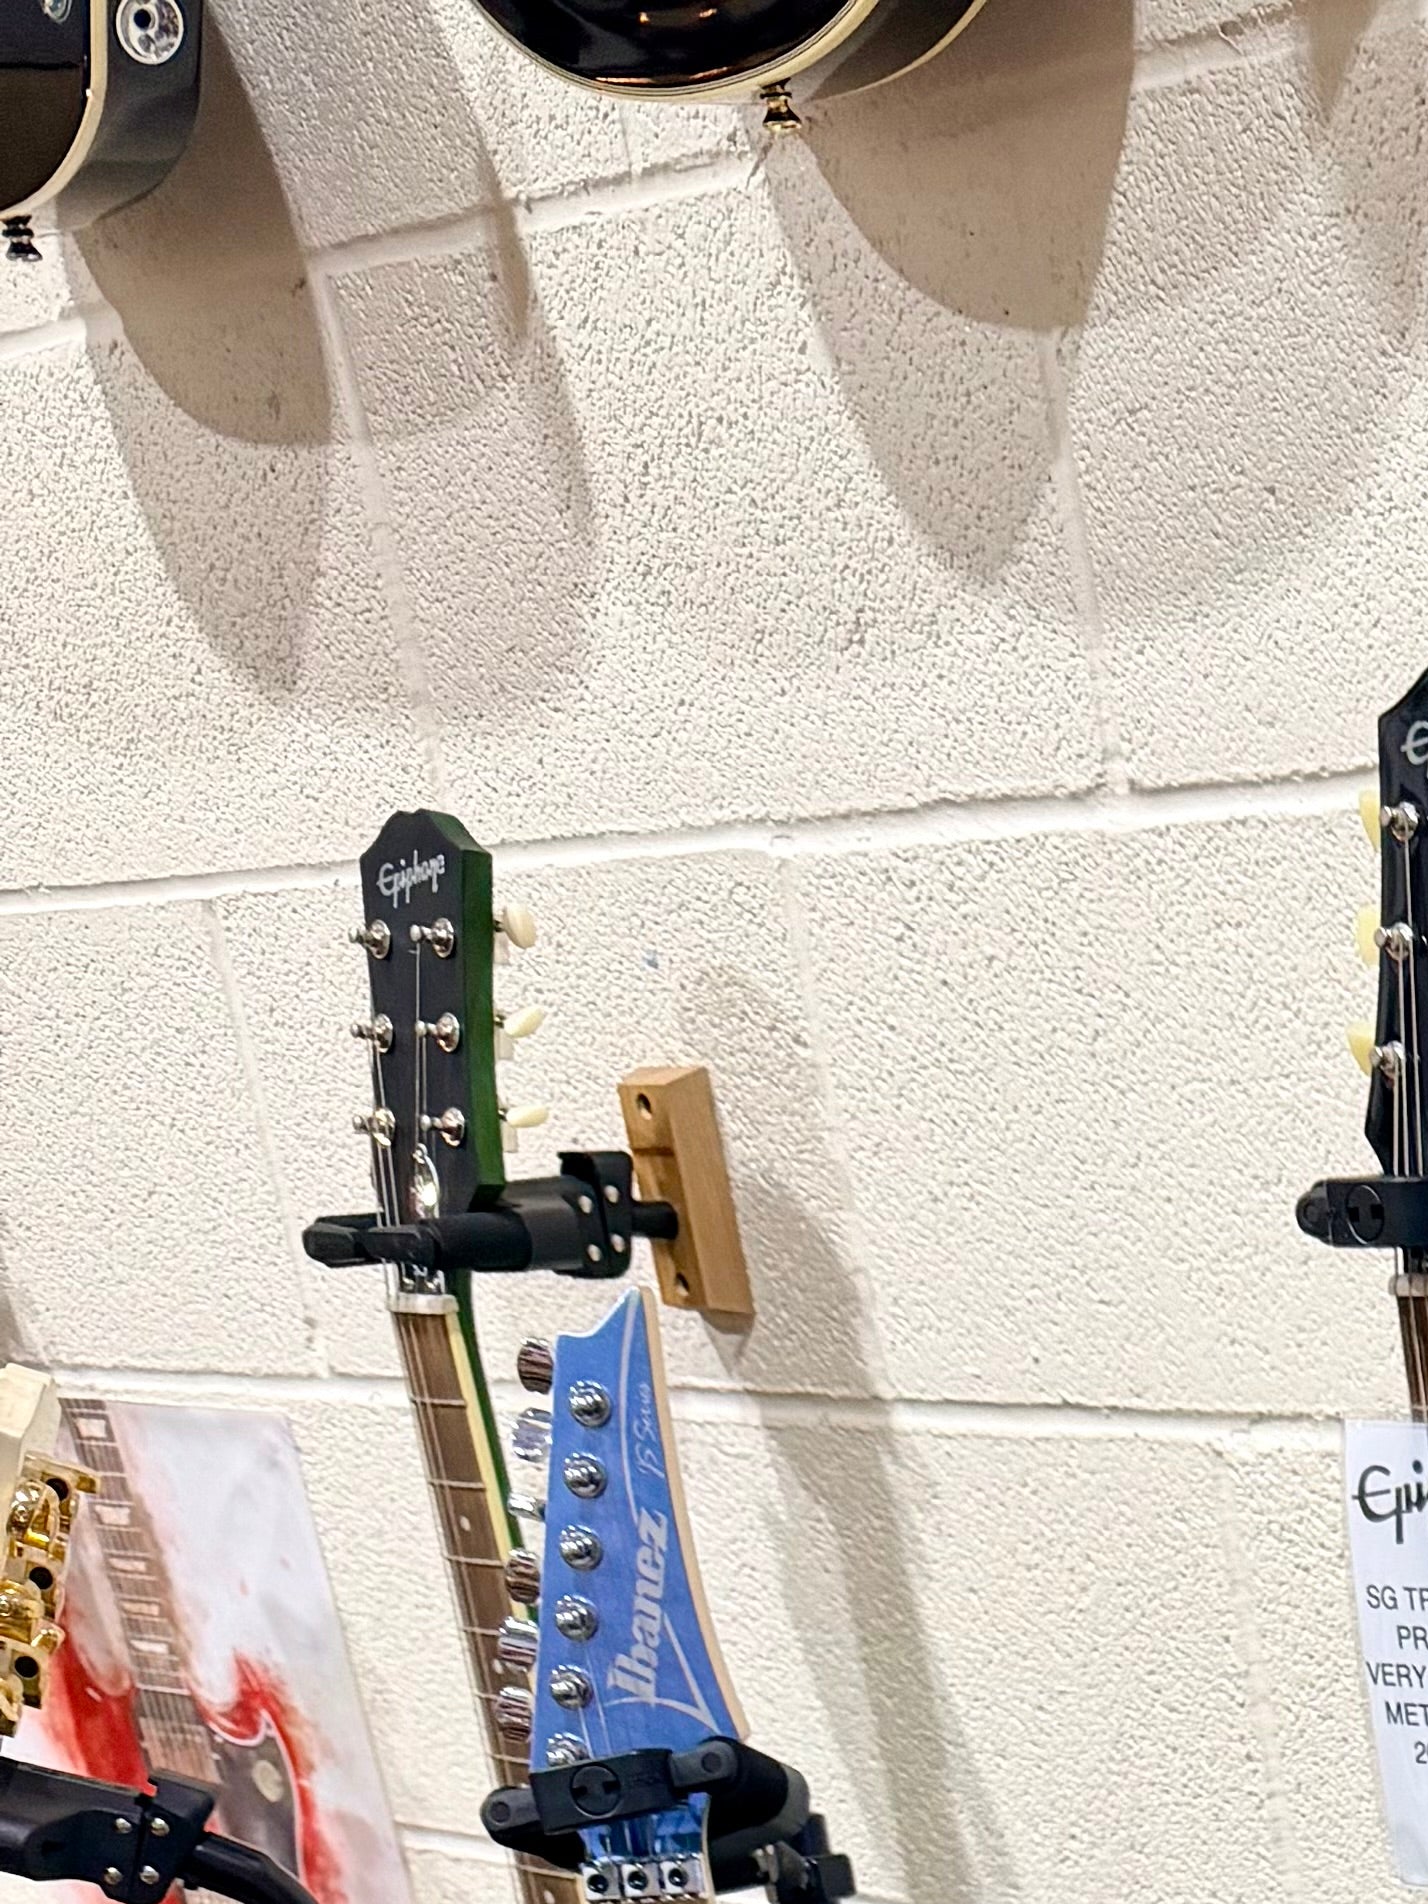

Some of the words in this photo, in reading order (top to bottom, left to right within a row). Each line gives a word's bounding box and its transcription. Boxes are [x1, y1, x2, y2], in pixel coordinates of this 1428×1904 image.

[376, 849, 446, 909] Epiphone
[607, 1509, 668, 1706] Ibanez
[1366, 1585, 1398, 1610] SG
[1366, 1661, 1427, 1690] VERY
